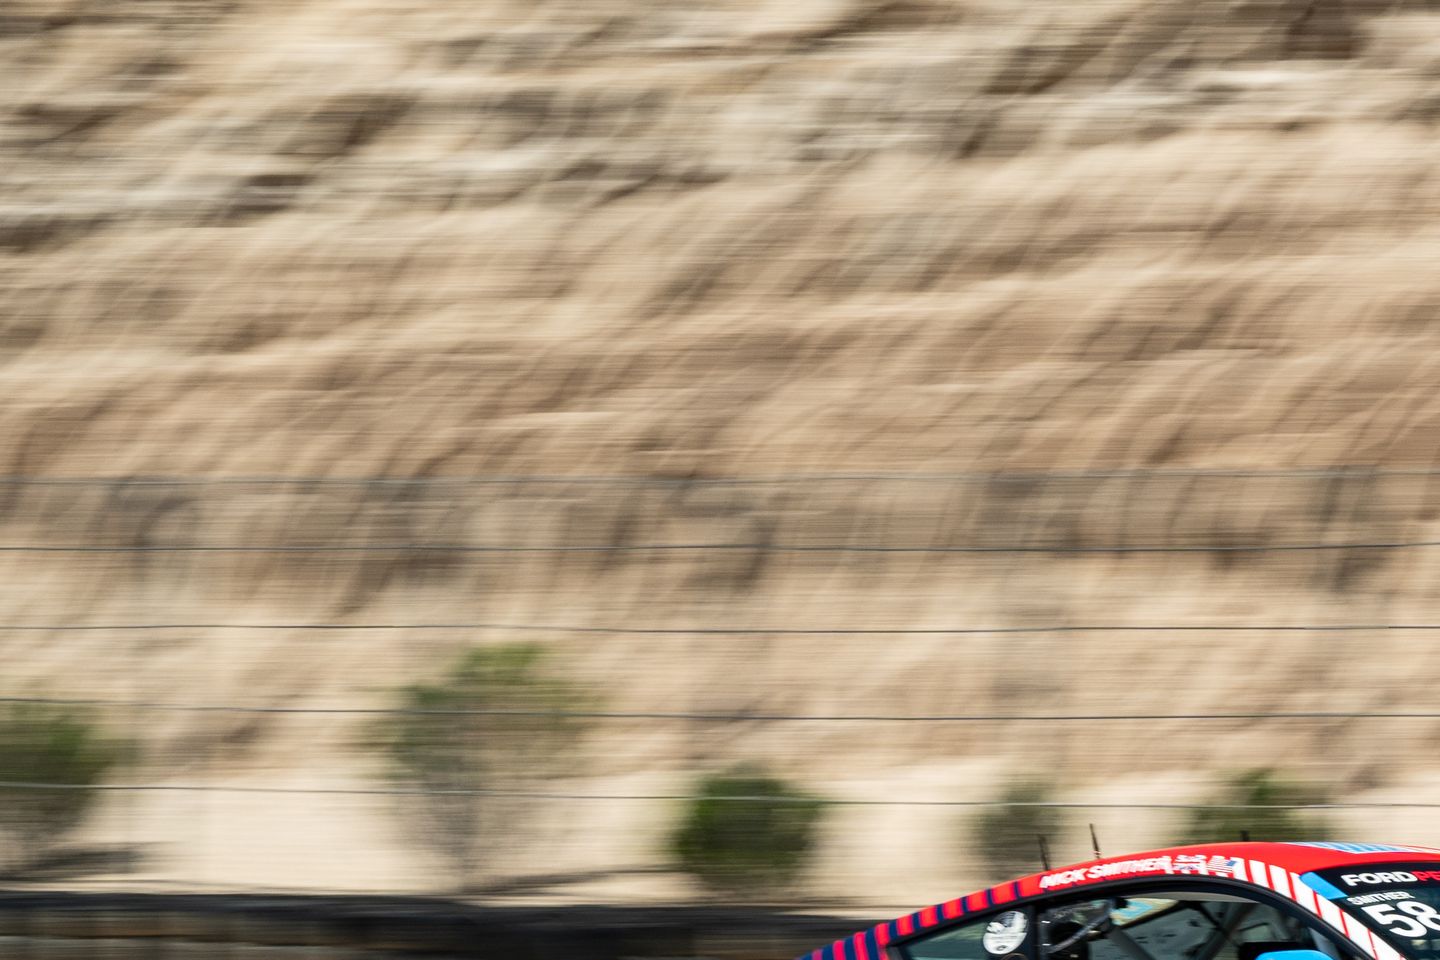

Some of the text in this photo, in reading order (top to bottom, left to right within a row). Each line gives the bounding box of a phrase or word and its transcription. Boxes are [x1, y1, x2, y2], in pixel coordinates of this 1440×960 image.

[1039, 855, 1173, 889] NICK SMITHER
[1347, 891, 1416, 906] SMITHER
